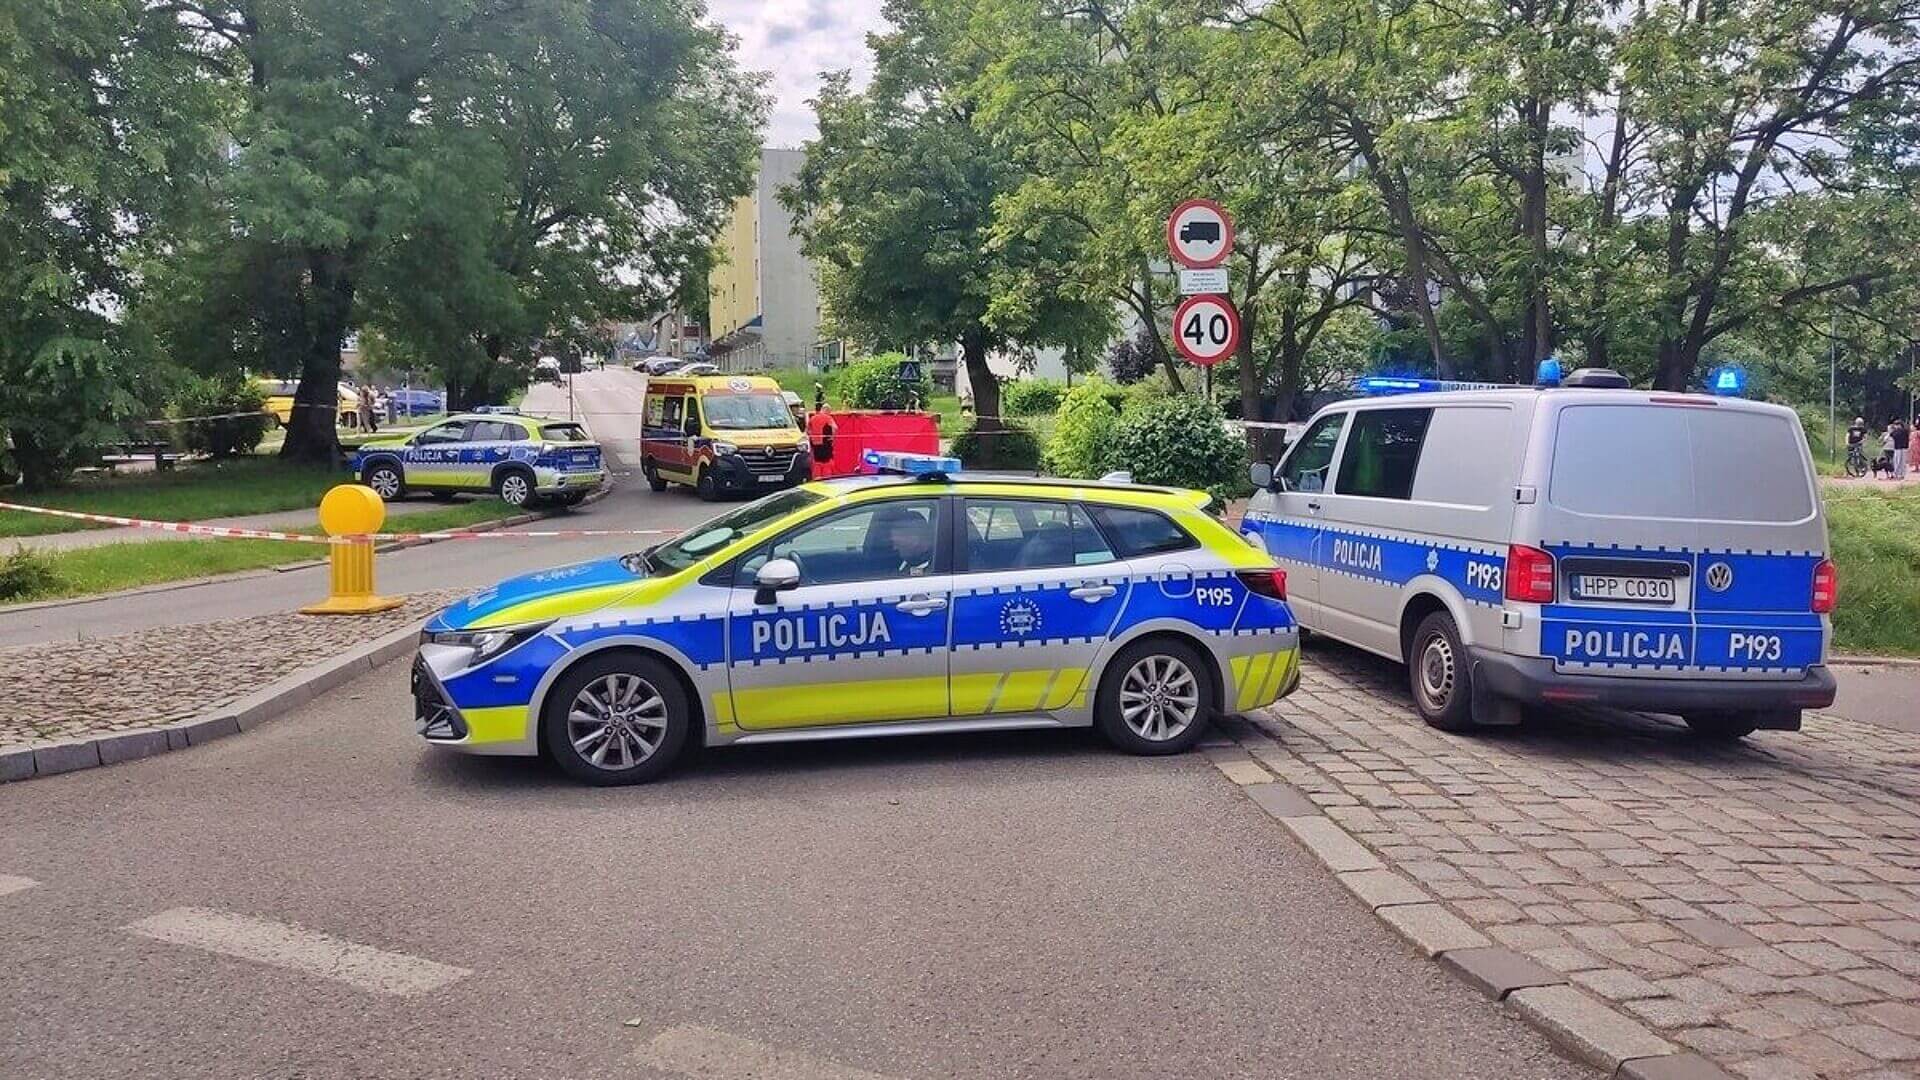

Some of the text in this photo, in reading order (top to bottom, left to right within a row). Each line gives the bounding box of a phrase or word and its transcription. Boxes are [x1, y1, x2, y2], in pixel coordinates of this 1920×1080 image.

[1183, 313, 1228, 345] 40
[408, 450, 442, 461] POLICJA
[1333, 538, 1382, 572] POLICJA
[1466, 560, 1501, 591] P193
[1583, 577, 1669, 599] HPP C030
[1196, 587, 1234, 607] P195
[752, 611, 891, 653] POLICJA
[1565, 630, 1685, 660] POLICJA
[1728, 633, 1781, 661] P193
